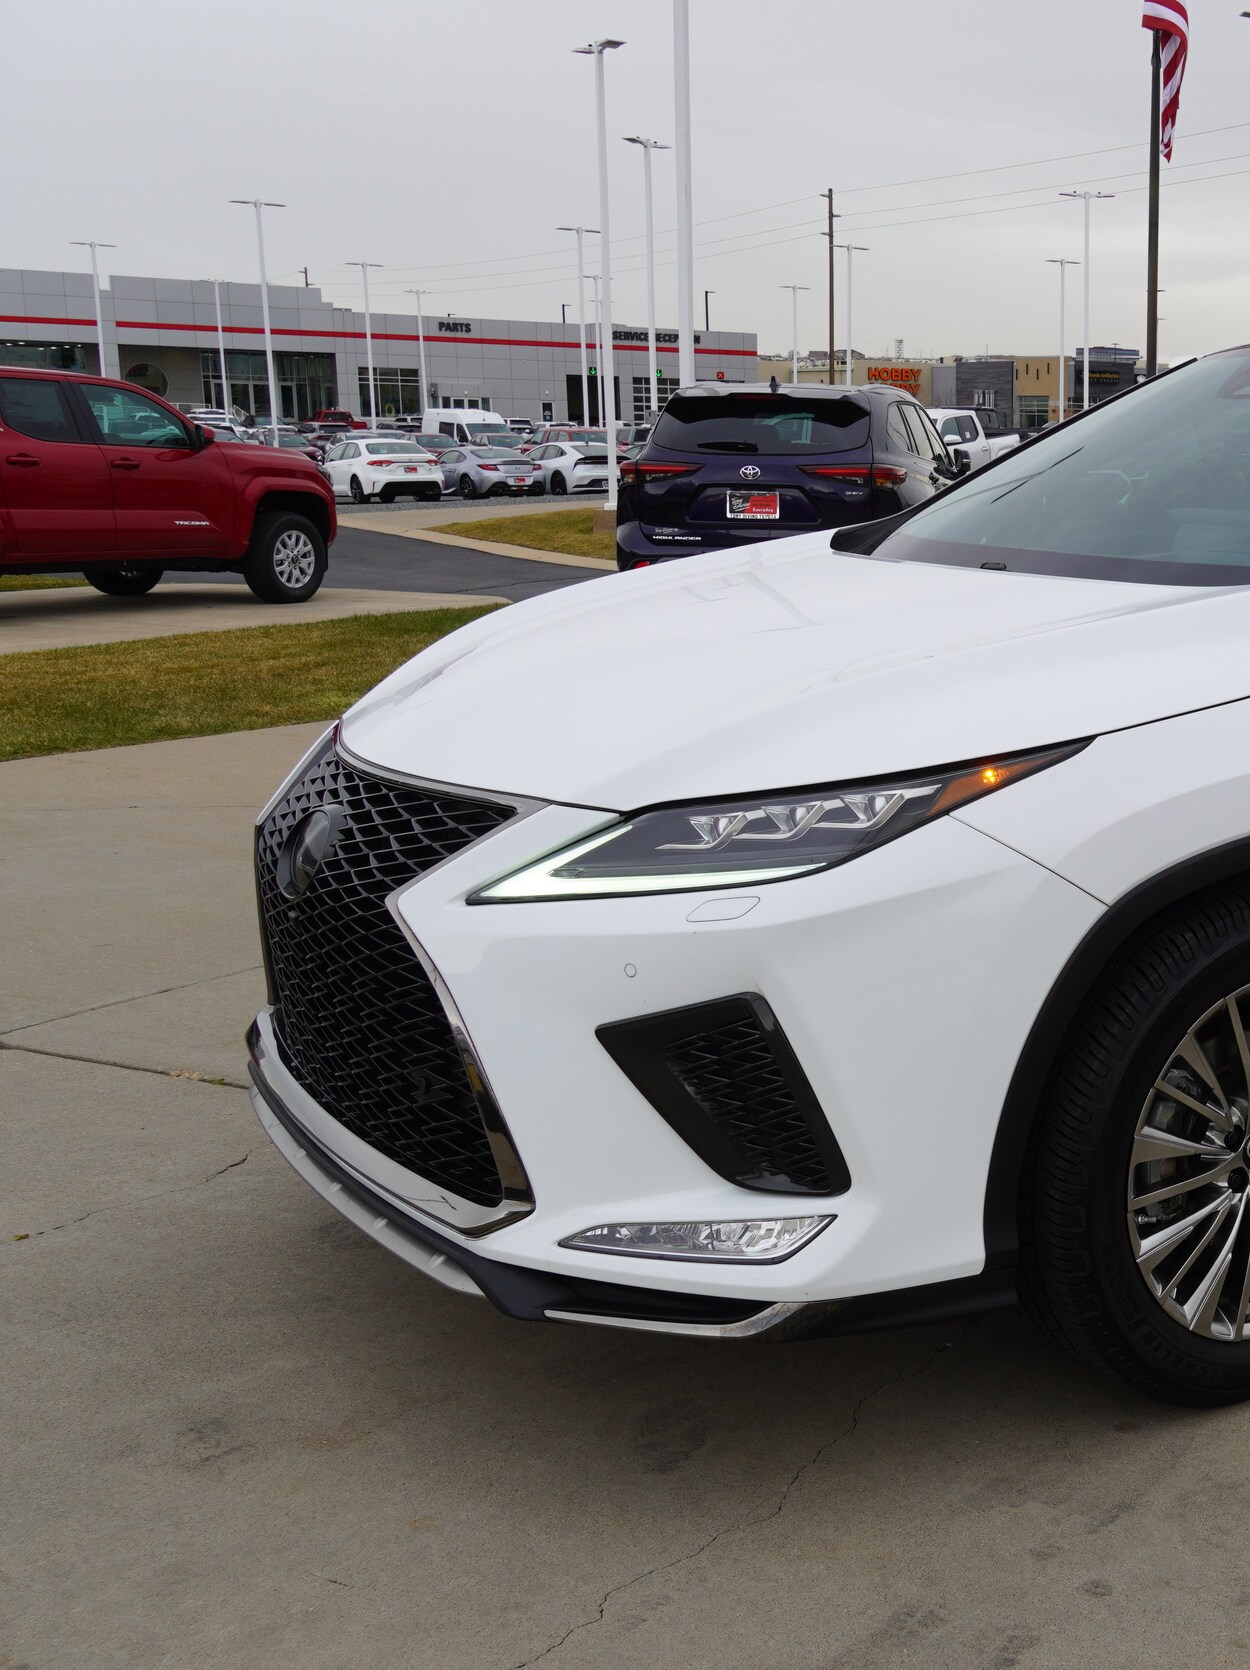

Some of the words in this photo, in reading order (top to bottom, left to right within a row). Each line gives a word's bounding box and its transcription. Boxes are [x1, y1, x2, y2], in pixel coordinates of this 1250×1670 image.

[438, 321, 472, 333] PARTS
[612, 331, 649, 342] SERVICE
[655, 333, 701, 344] ECEPN
[868, 367, 921, 382] HOBBY
